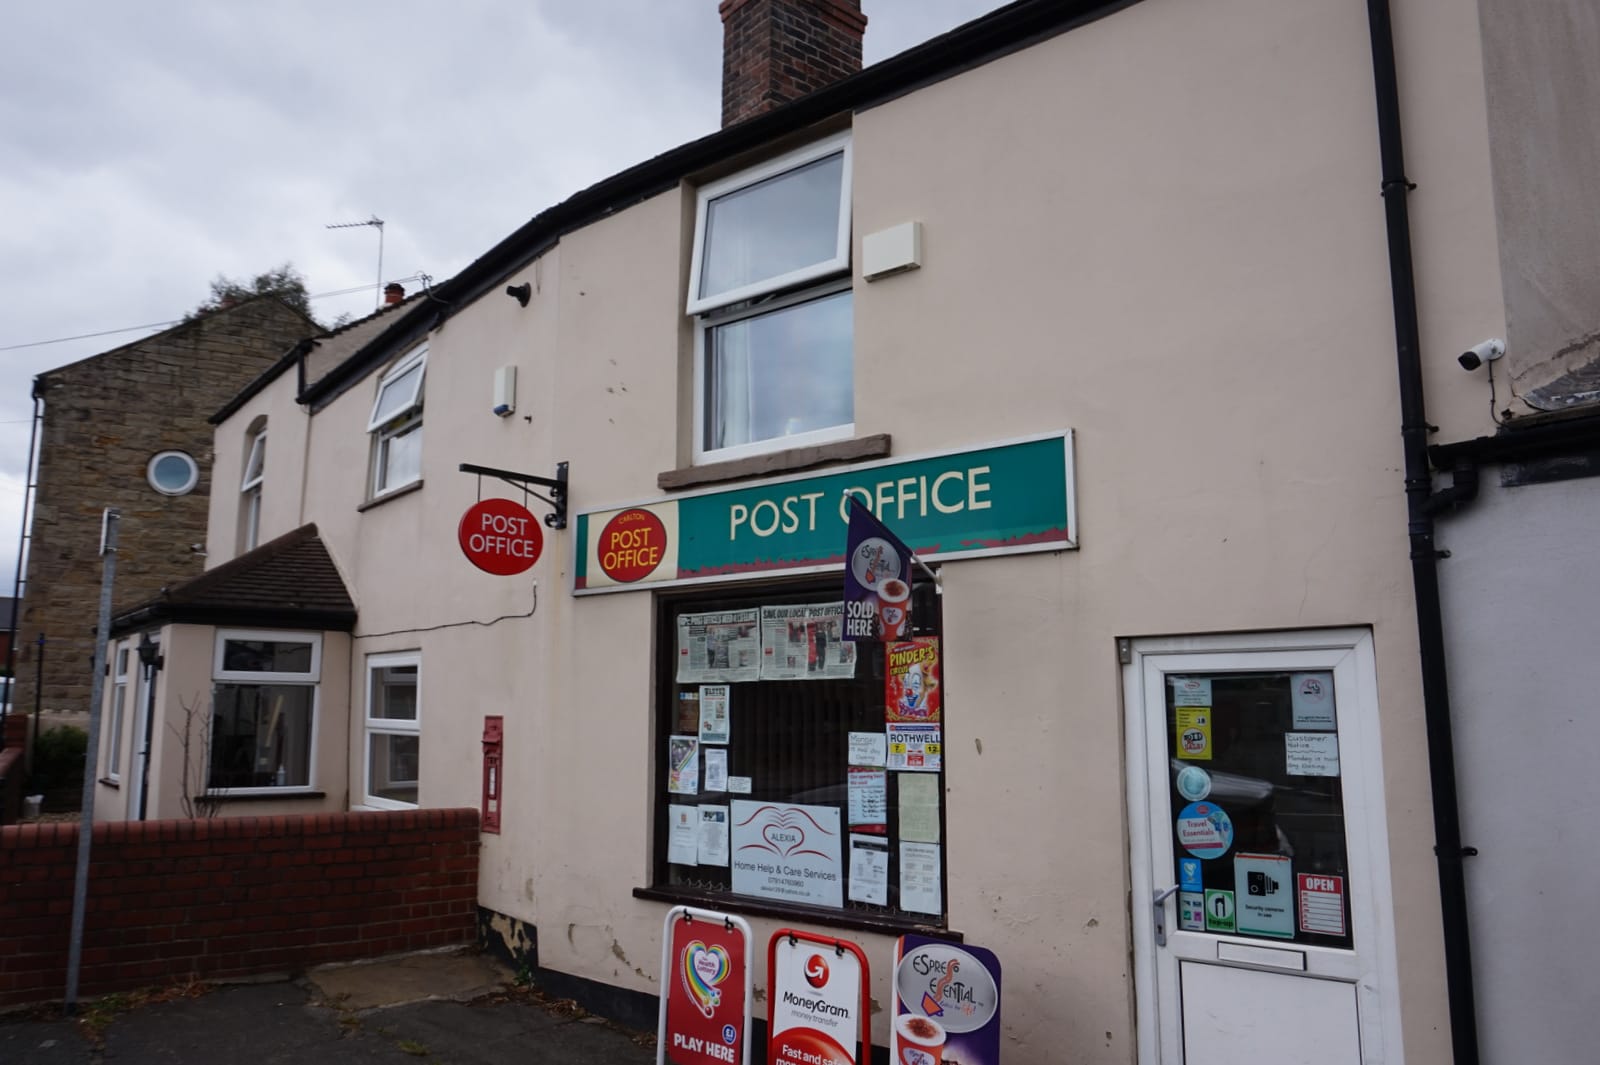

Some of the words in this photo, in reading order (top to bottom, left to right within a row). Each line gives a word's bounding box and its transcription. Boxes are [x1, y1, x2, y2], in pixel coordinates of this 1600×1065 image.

[730, 493, 825, 541] POST
[839, 466, 992, 525] OFFICE
[481, 513, 528, 536] POST
[618, 512, 645, 525] CARLTON
[469, 534, 534, 558] OFFICE
[610, 528, 652, 550] POST
[604, 547, 658, 570] OFFICE
[763, 608, 776, 619] SAVE
[776, 608, 788, 618] OUR
[788, 607, 806, 618] LOCAL
[808, 606, 824, 617] POST
[847, 601, 874, 618] SOLD
[847, 619, 873, 636] HERE
[890, 646, 936, 666] PINDER'S
[891, 734, 941, 743] ROTHWELL
[1187, 820, 1207, 828] Travel
[771, 833, 796, 843] ALEXIA
[1182, 829, 1214, 838] Essentials
[734, 862, 755, 871] Home
[757, 864, 774, 874] Help
[776, 865, 781, 874] &
[784, 866, 802, 877] Care
[804, 868, 836, 881] Services
[1306, 877, 1335, 891] OPEN
[1245, 904, 1264, 912] Security
[698, 959, 715, 969] Health
[783, 991, 848, 1019] MoneyGram
[791, 1010, 812, 1021] money
[812, 1015, 839, 1027] transfer
[674, 1033, 703, 1051] PLAY
[706, 1042, 735, 1063] HERE
[782, 1044, 802, 1059] Fast
[803, 1052, 821, 1064] and
